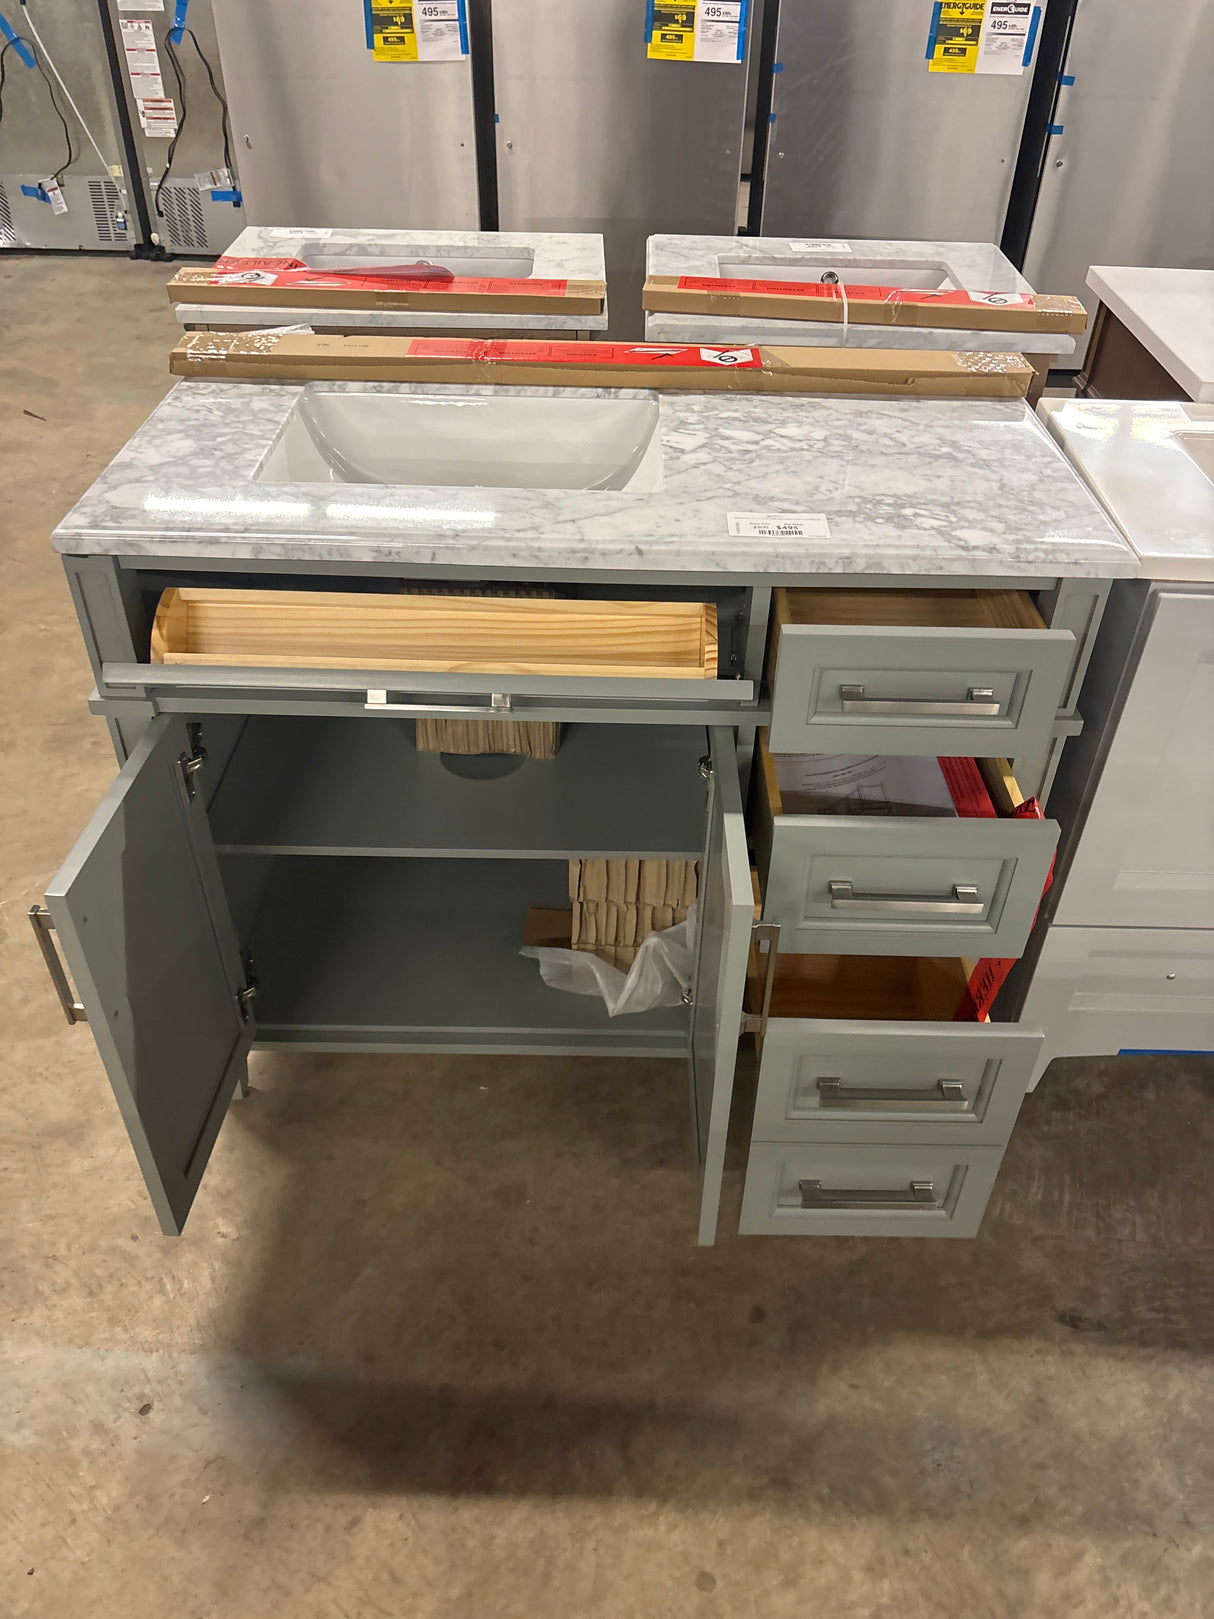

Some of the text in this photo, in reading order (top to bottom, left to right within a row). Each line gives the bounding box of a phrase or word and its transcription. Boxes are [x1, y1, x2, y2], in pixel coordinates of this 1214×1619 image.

[422, 7, 438, 16] 495
[705, 7, 721, 17] 495
[991, 20, 1008, 30] 495
